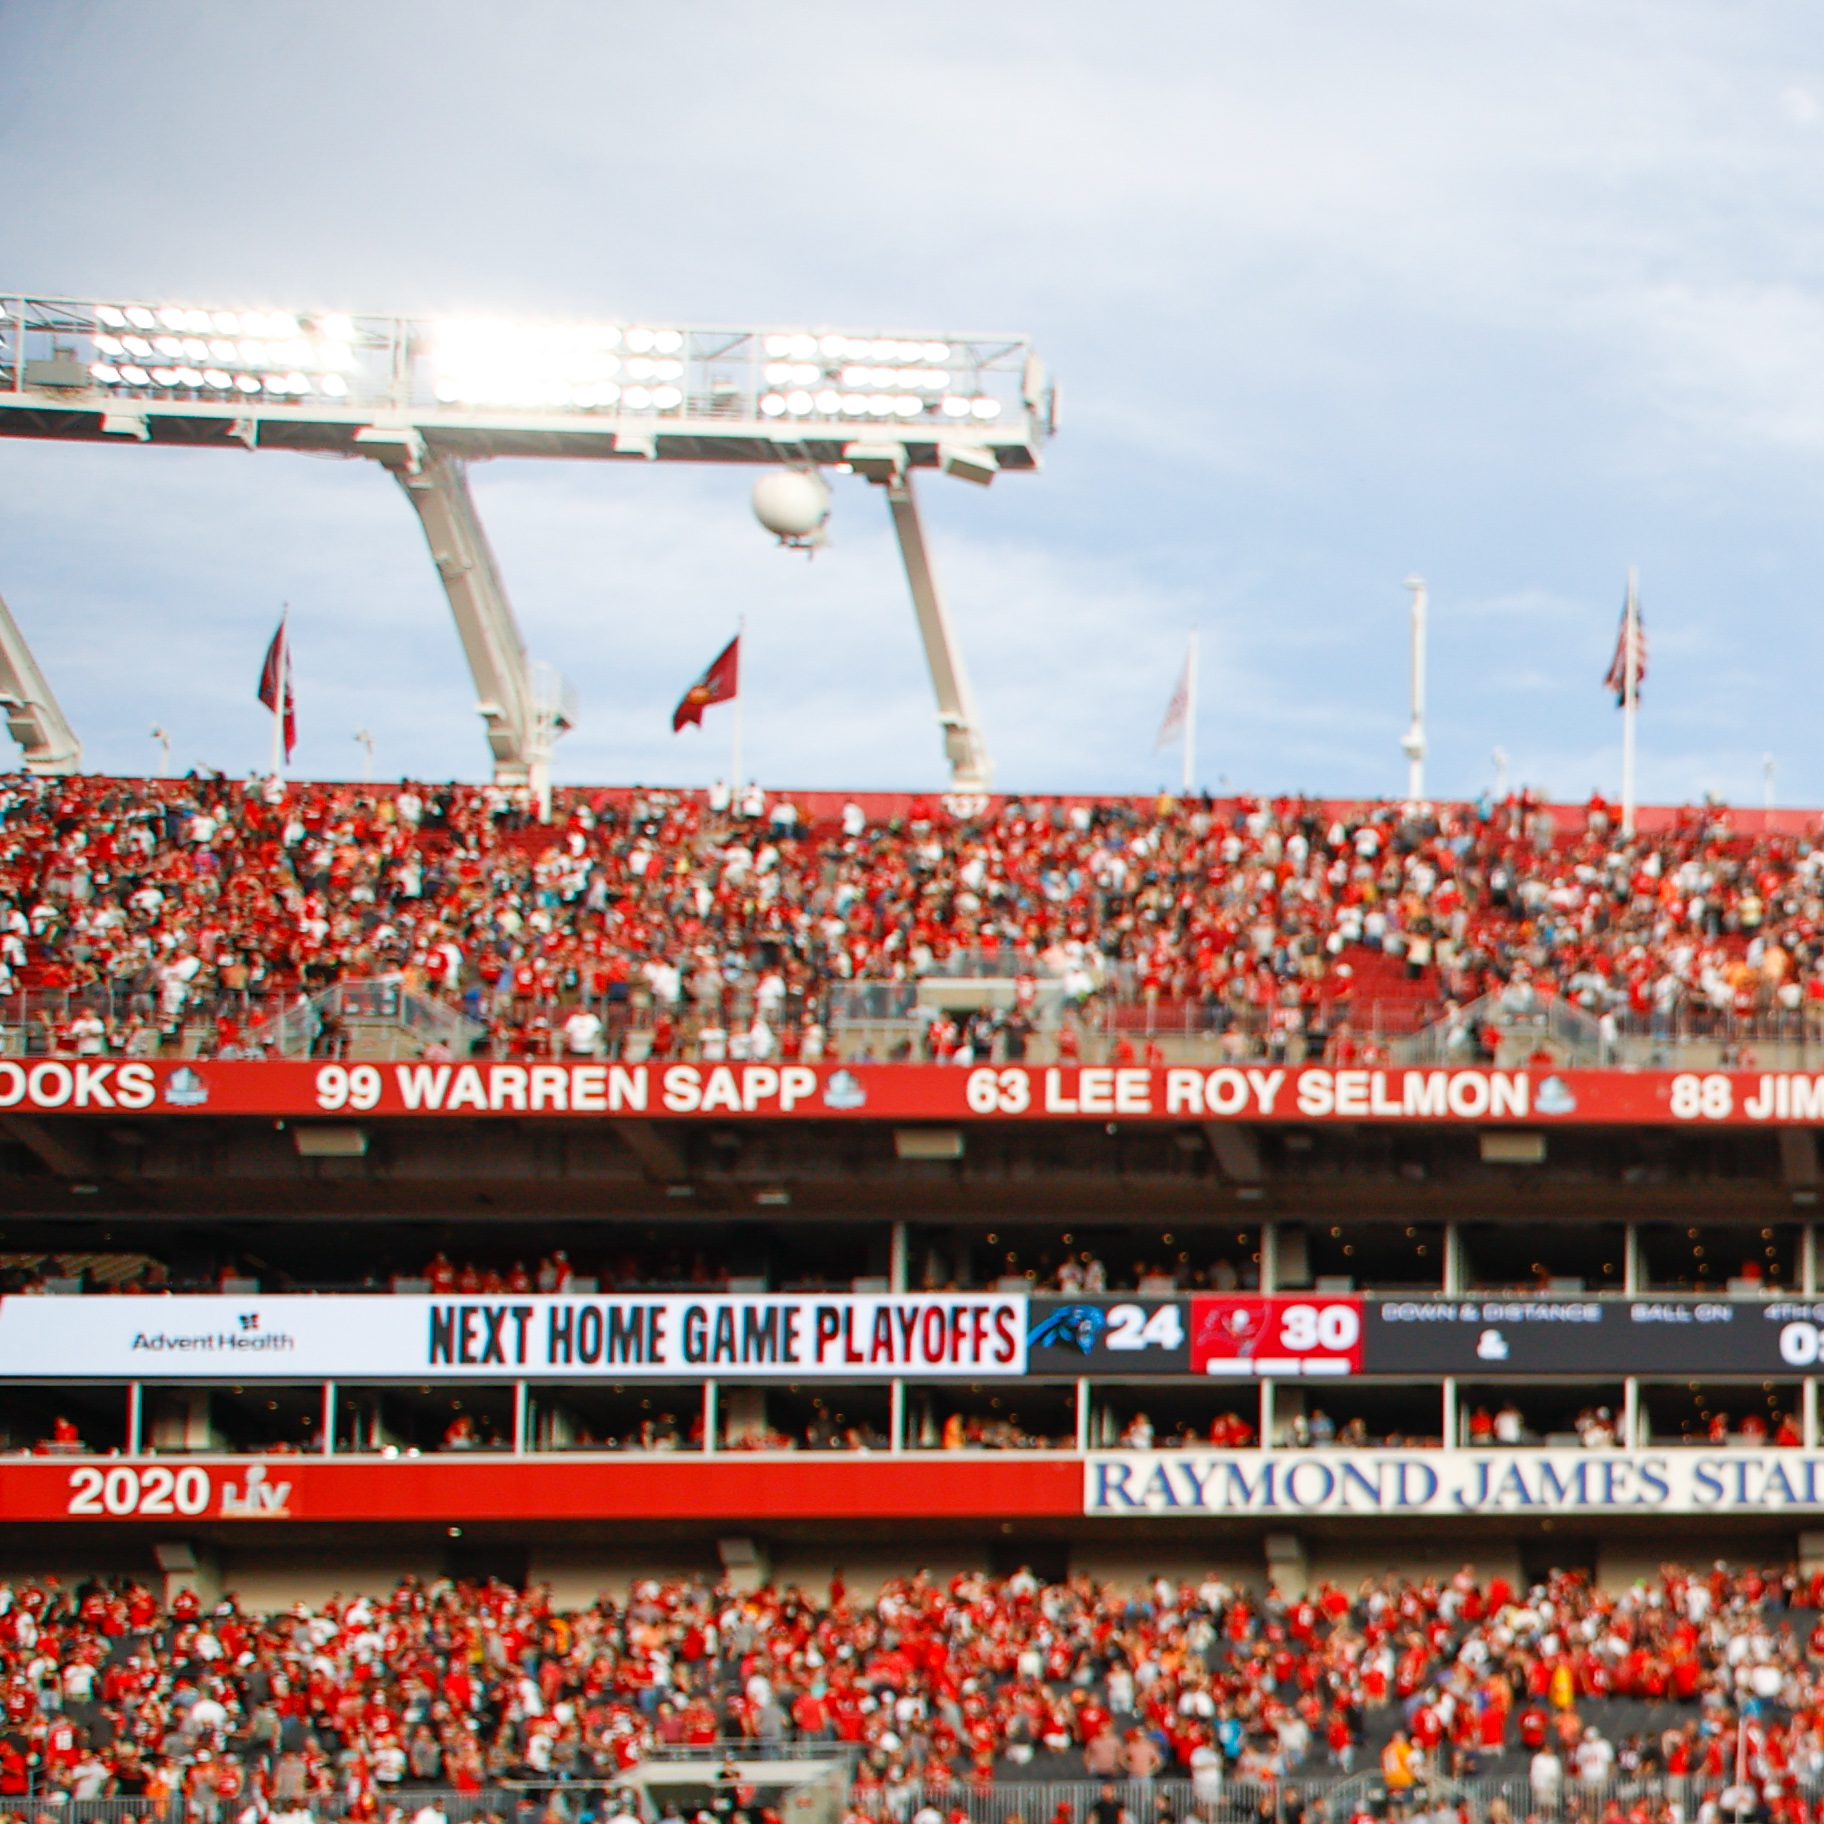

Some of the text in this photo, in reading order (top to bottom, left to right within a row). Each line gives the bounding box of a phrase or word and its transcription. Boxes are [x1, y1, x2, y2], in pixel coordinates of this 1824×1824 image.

[0, 1061, 156, 1108] OOKS
[315, 1064, 818, 1111] 99 WARREN SAPP
[967, 1068, 1529, 1117] 63 LEE ROY SELMON
[1670, 1074, 1732, 1119] 88
[428, 1304, 1018, 1365] NEXT HOME GAME PLAYOFFS
[1105, 1305, 1360, 1351] 24 30
[1630, 1304, 1690, 1323] BALL
[132, 1333, 294, 1352] AdventHealth
[1477, 1330, 1508, 1361] &
[68, 1467, 210, 1515] 2020
[1096, 1459, 1438, 1509] RAYMOND
[1453, 1459, 1669, 1512] JAMES
